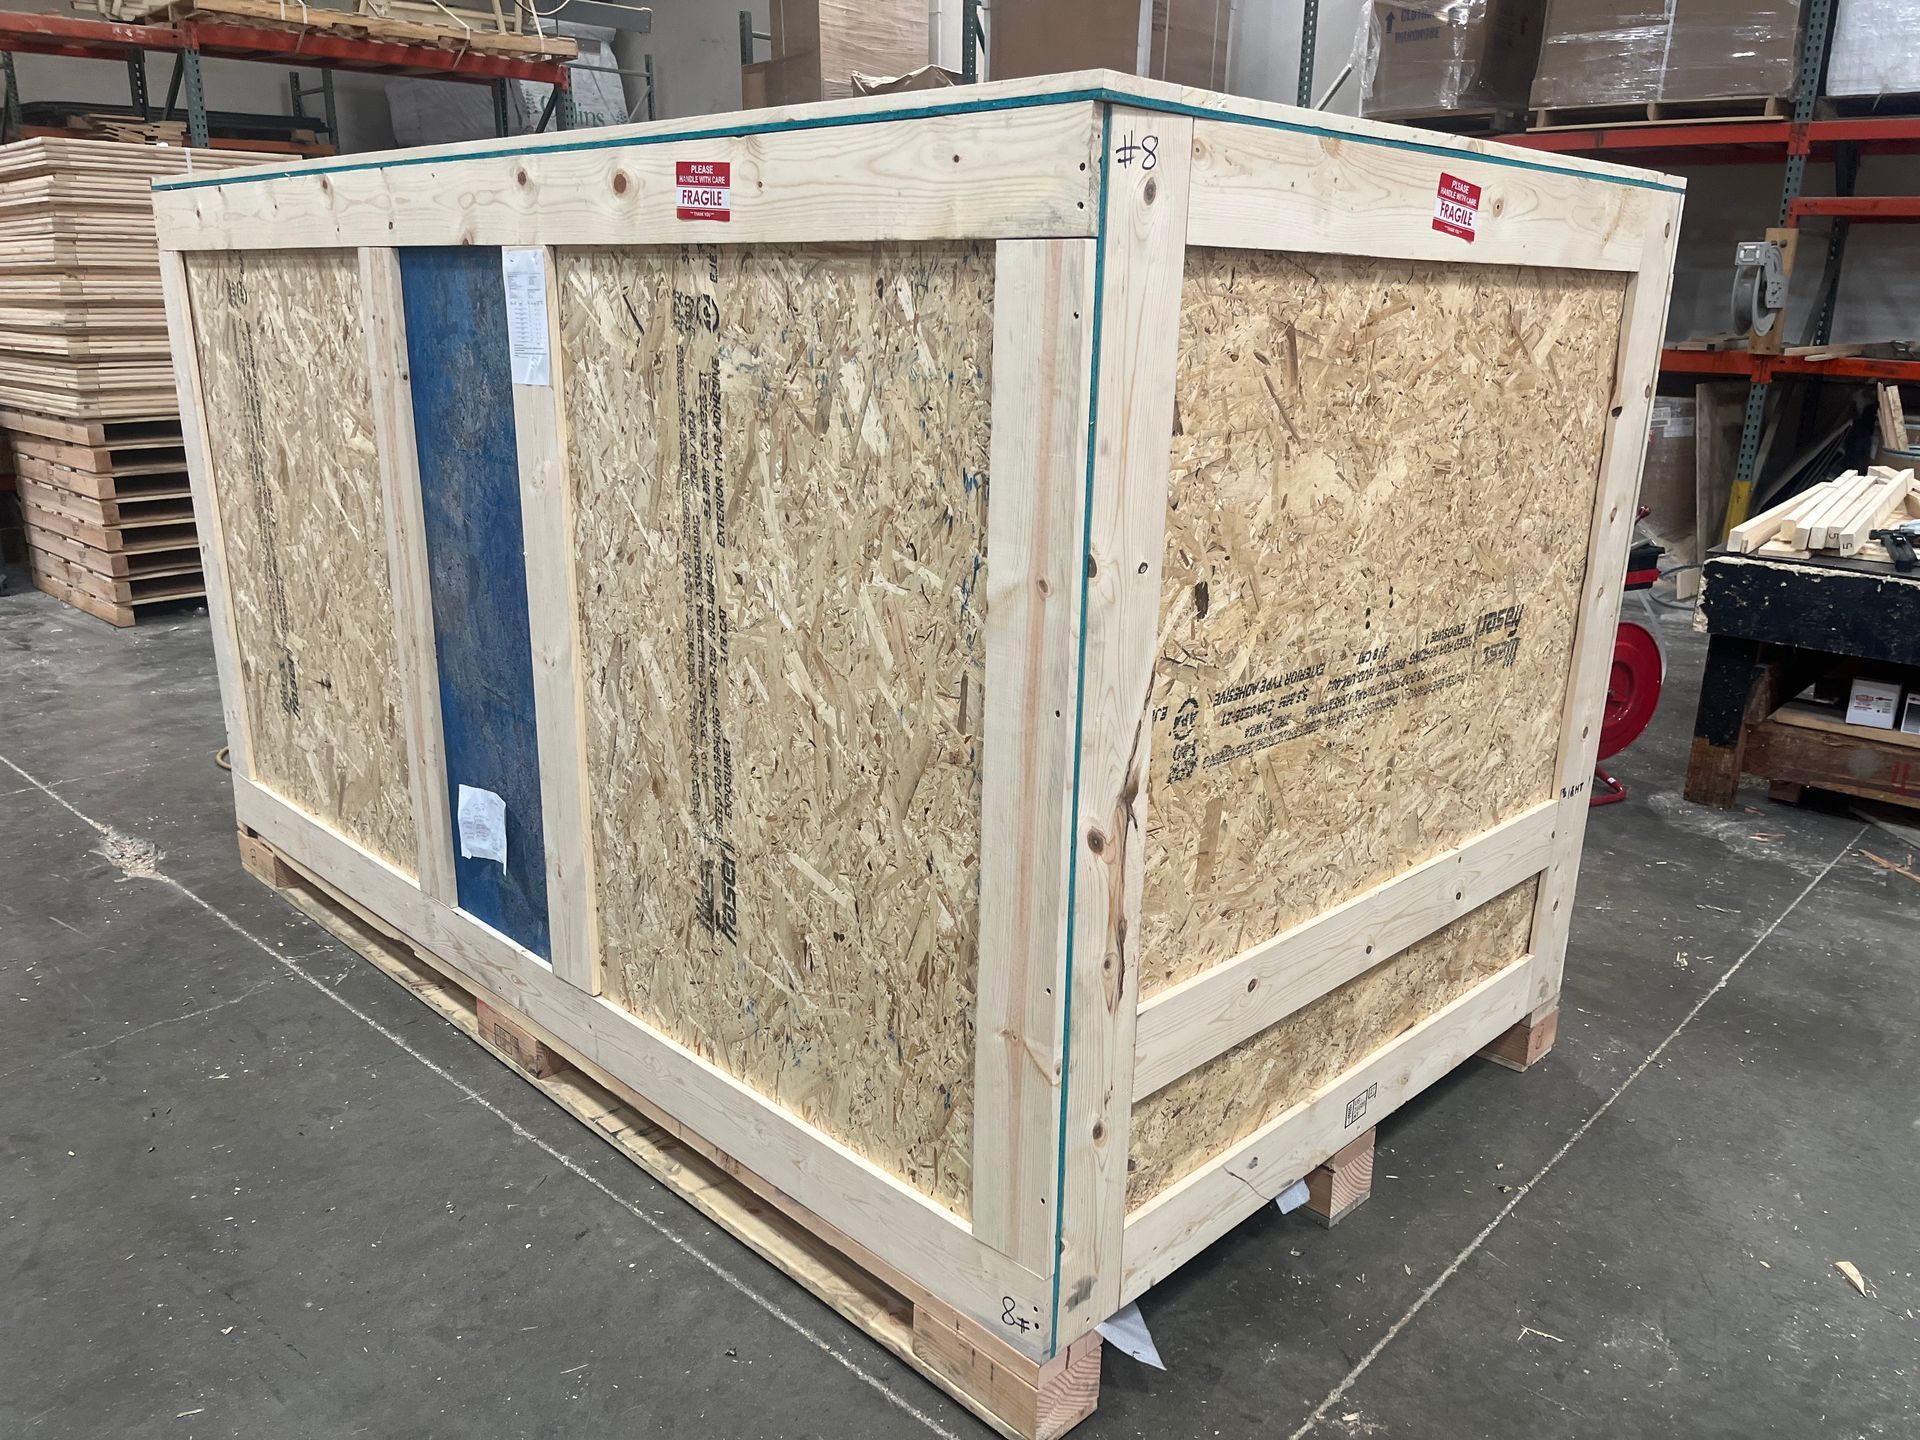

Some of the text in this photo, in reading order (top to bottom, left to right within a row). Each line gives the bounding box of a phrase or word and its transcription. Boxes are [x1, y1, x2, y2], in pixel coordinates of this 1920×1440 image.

[1116, 130, 1158, 170] #8
[679, 175, 725, 185] HANDLE WITH CARE
[691, 165, 714, 174] PLEASE
[682, 190, 722, 206] FRAGILE
[1441, 187, 1477, 207] HANDLE WITH CARE
[1451, 180, 1470, 194] PLEASE
[1440, 202, 1473, 226] FRAGILE
[711, 355, 725, 547] EXTERIOR TYPE ADHESIVE
[718, 605, 727, 632] CAT
[1476, 603, 1524, 647] Fraser
[1429, 622, 1465, 643] EXPOSURE
[1356, 650, 1371, 665] CAT
[1212, 662, 1323, 707] EXTERIOR TYPE ADHESIVE
[712, 705, 721, 766] SPACING
[713, 767, 721, 795] FOR
[723, 748, 732, 819] EXPOSURE
[714, 799, 723, 833] SIZED
[713, 843, 737, 946] Fraser
